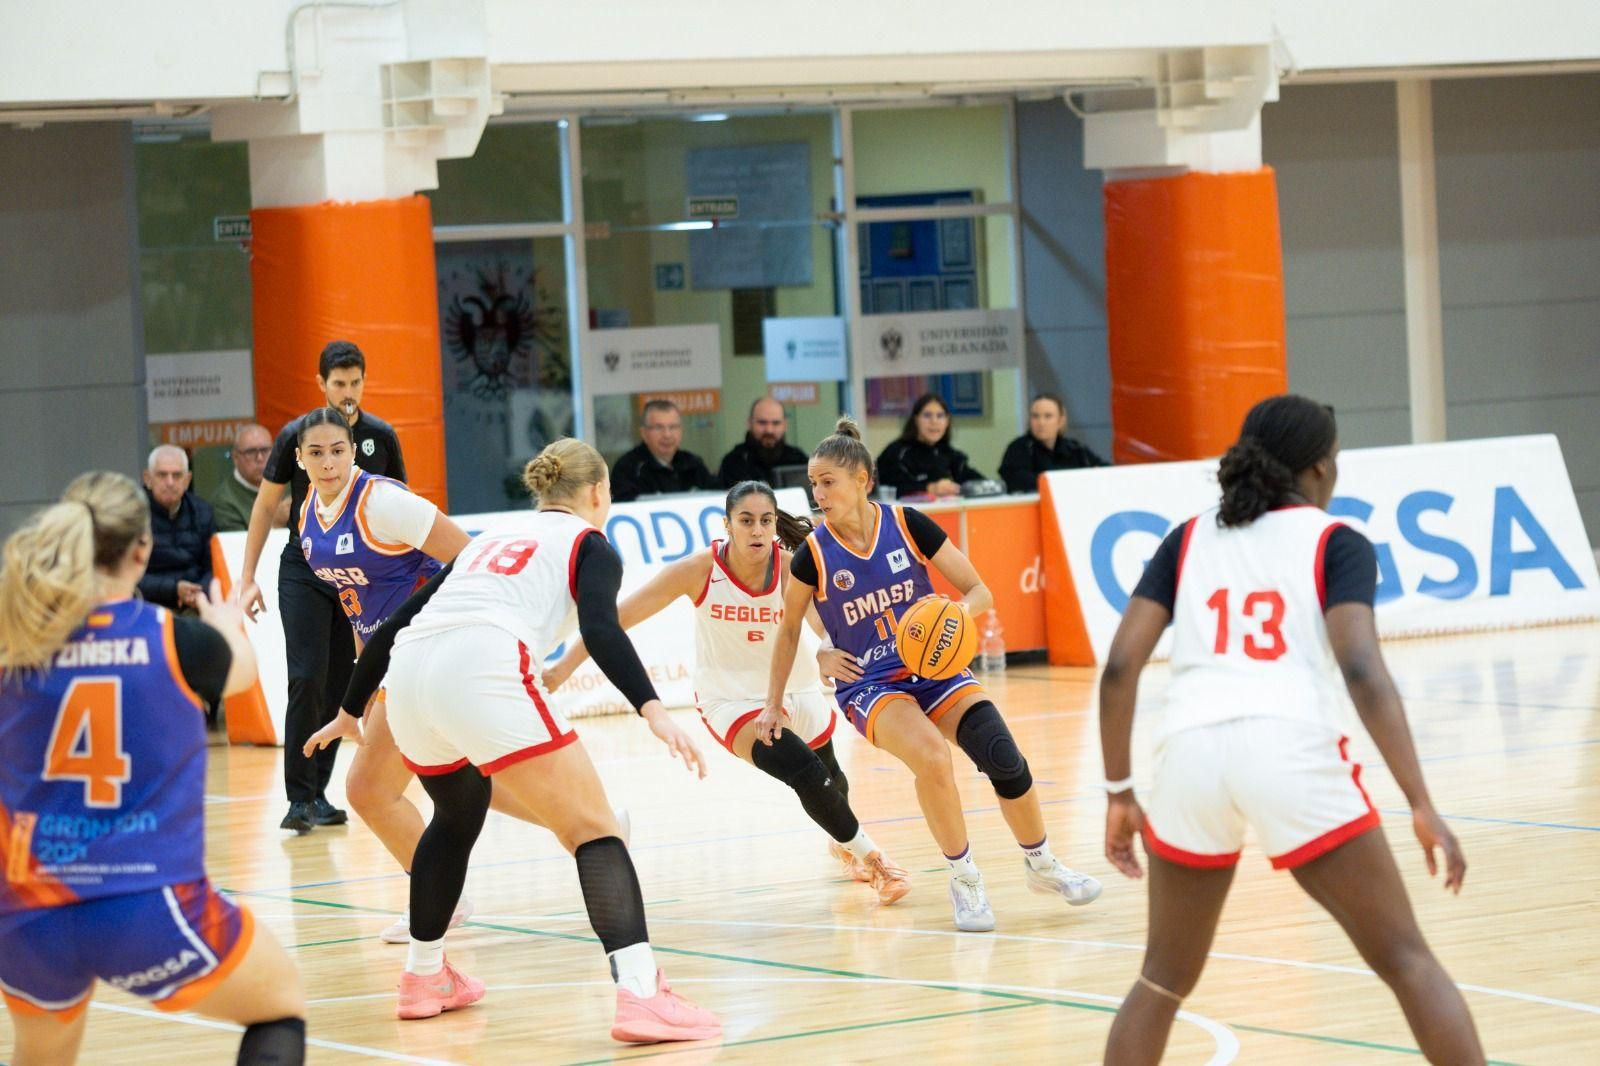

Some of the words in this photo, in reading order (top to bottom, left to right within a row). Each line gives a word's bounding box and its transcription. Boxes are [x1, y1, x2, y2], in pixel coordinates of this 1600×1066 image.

[919, 325, 1009, 342] UNIVERSIDAD
[921, 344, 935, 357] DE
[939, 338, 1009, 355] GRANADA
[466, 538, 539, 577] 18
[842, 578, 914, 627] GMASB
[1205, 587, 1288, 661] 13
[747, 630, 765, 642] 6
[928, 617, 958, 667] Wilson
[40, 675, 132, 809] 4
